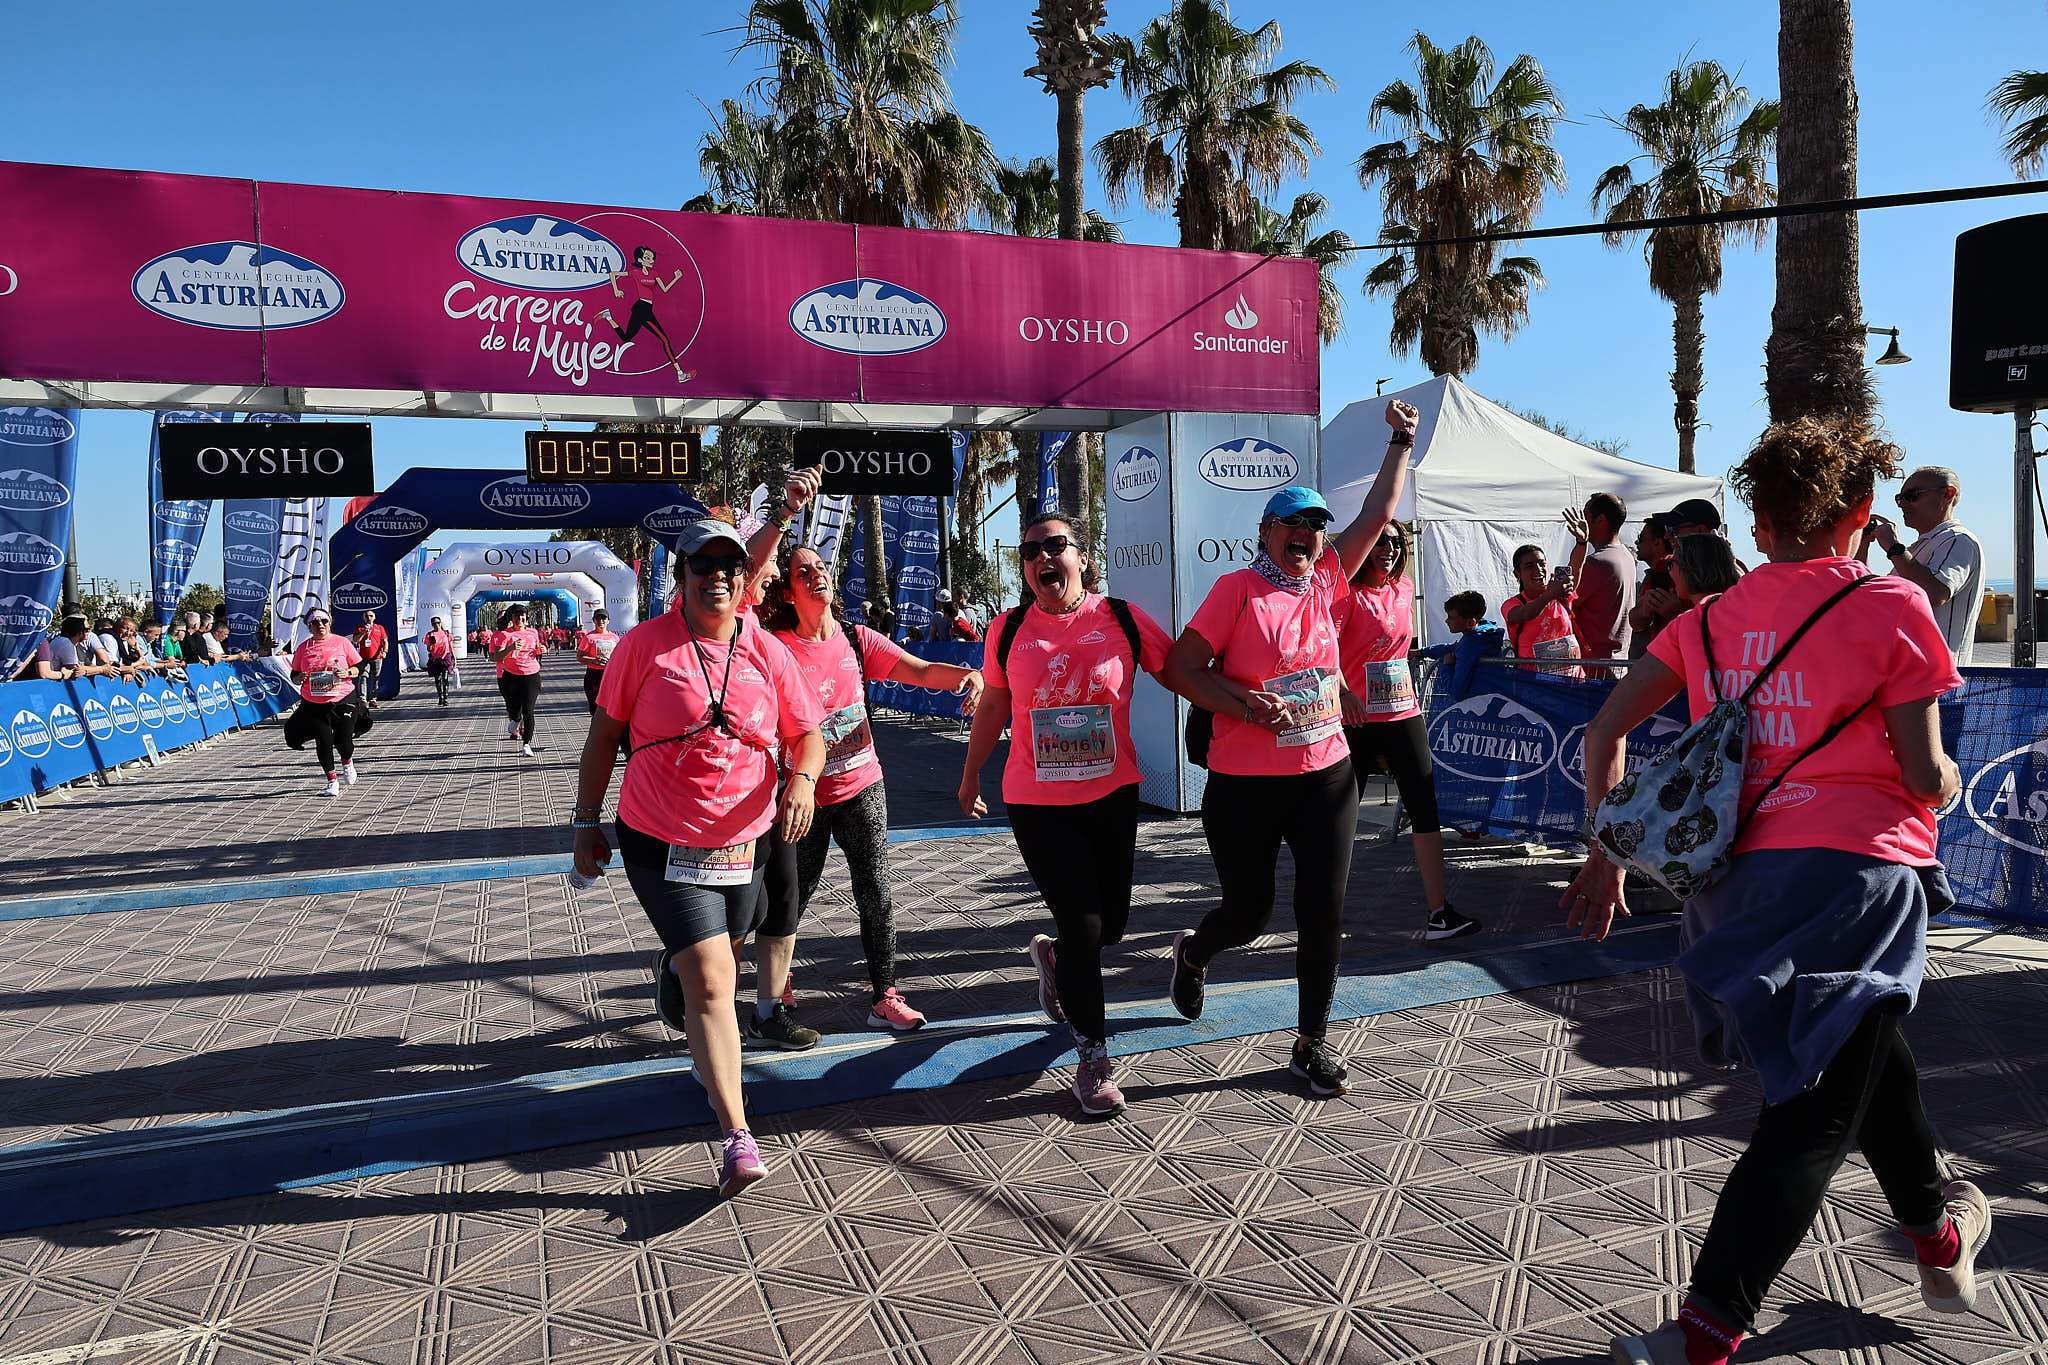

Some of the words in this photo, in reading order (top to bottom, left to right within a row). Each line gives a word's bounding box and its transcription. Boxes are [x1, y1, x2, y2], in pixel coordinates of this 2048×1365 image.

[470, 238, 613, 274] ASTURIANA
[496, 238, 550, 249] CENTRAL
[555, 242, 608, 253] LECHERA
[182, 269, 250, 281] CENTRAL
[151, 270, 330, 309] ASTURIANA
[443, 280, 583, 325] Carrera
[826, 303, 875, 313] CENTRAL
[880, 305, 929, 315] LECHERA
[802, 303, 935, 336] ASTURIANA
[1019, 316, 1129, 345] OYSHO
[479, 323, 506, 351] de
[512, 324, 531, 352] la
[528, 322, 636, 386] Mujer
[1193, 331, 1288, 354] Santander
[196, 447, 344, 475] OYSHO
[538, 440, 689, 475] 00:59:38
[820, 449, 931, 476] OYSHO
[1206, 457, 1292, 478] ASTURIANA
[1115, 469, 1157, 491] ASTURIANA
[489, 487, 583, 507] ASTURIANA
[906, 502, 938, 514] ASTURIA
[359, 518, 423, 530] ASTURIANA
[276, 497, 310, 624] OYSH
[484, 548, 572, 566] OYSHO
[1114, 541, 1163, 569] OYSHO
[1197, 538, 1255, 563] OYS
[334, 593, 384, 605] ASTURIANA
[1741, 631, 1777, 667] TU
[1298, 699, 1325, 716] 016
[1456, 719, 1498, 732] CENTRAL
[1500, 722, 1545, 738] LECHERA
[1751, 710, 1797, 748] MA
[1061, 739, 1090, 752] 016
[1433, 720, 1544, 765] ASTURIANA
[673, 860, 697, 868] CARRERA
[676, 870, 707, 879] OYSHO
